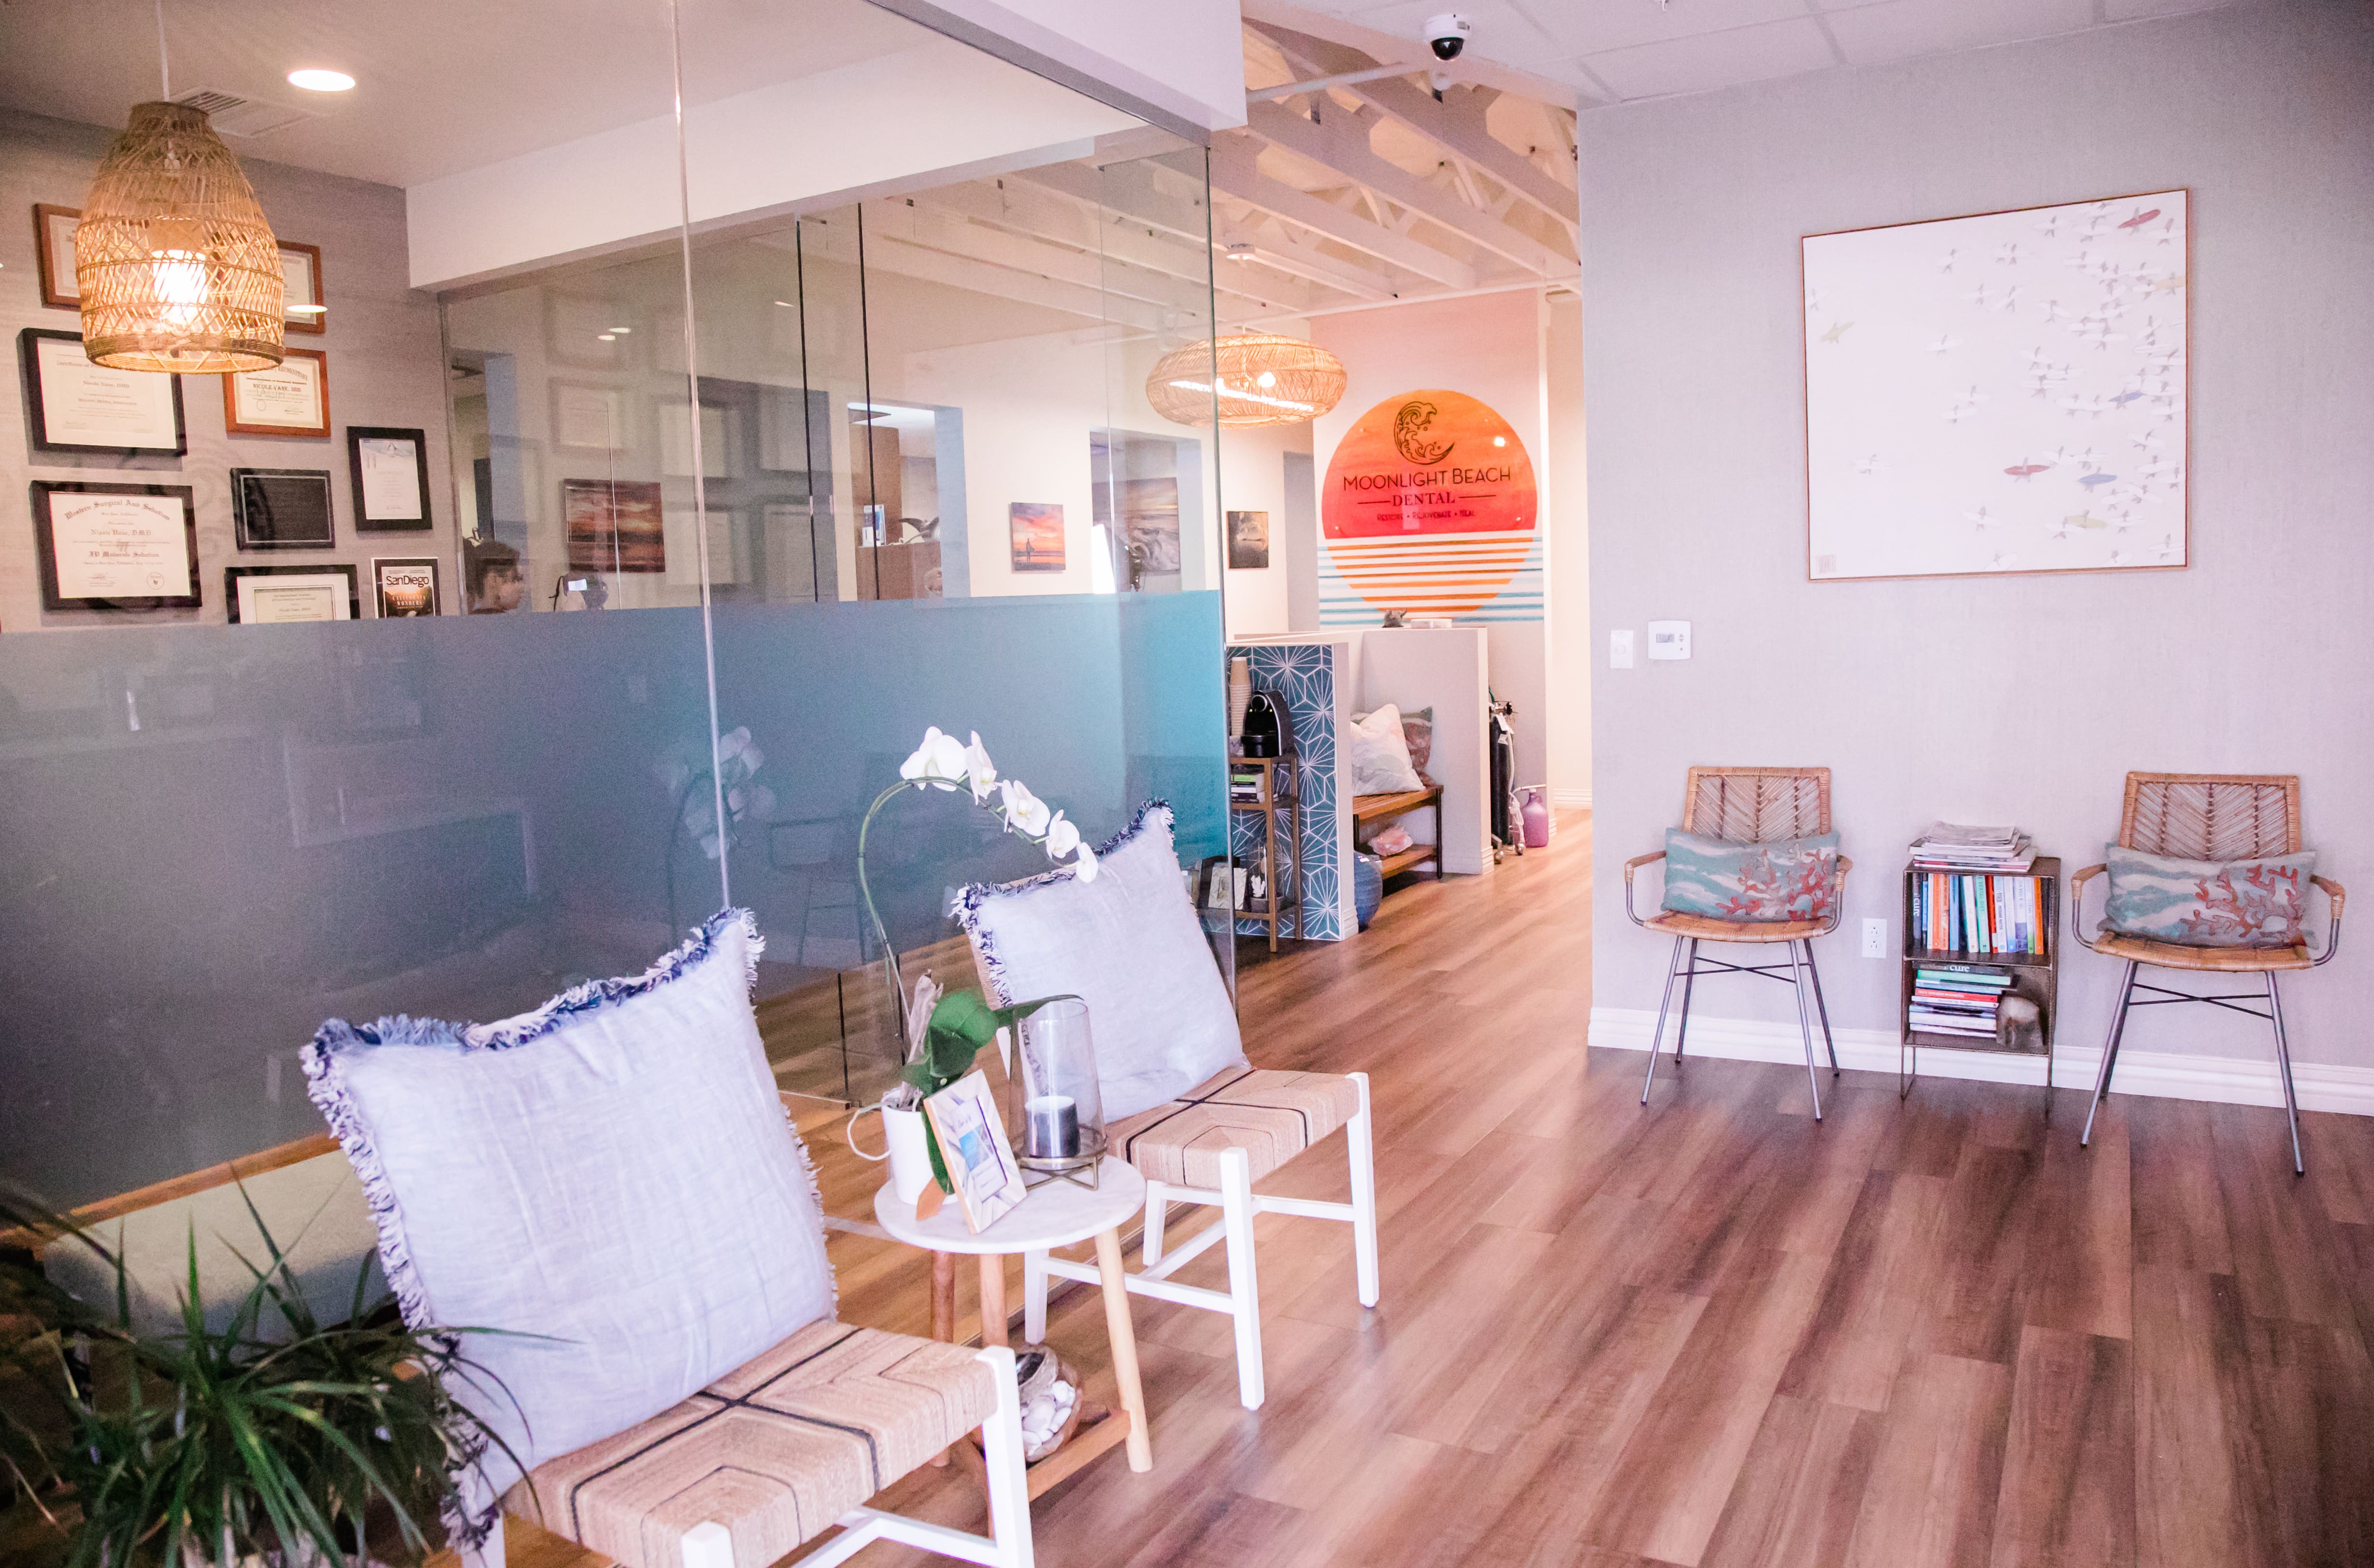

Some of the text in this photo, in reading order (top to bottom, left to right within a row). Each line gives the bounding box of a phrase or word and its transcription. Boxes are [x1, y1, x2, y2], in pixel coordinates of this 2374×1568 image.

[1343, 466, 1511, 491] MOONLIGHT BEACH
[93, 499, 122, 508] Surgical
[126, 499, 140, 508] And
[143, 503, 170, 521] Sedation
[1393, 491, 1455, 507] DENTAL
